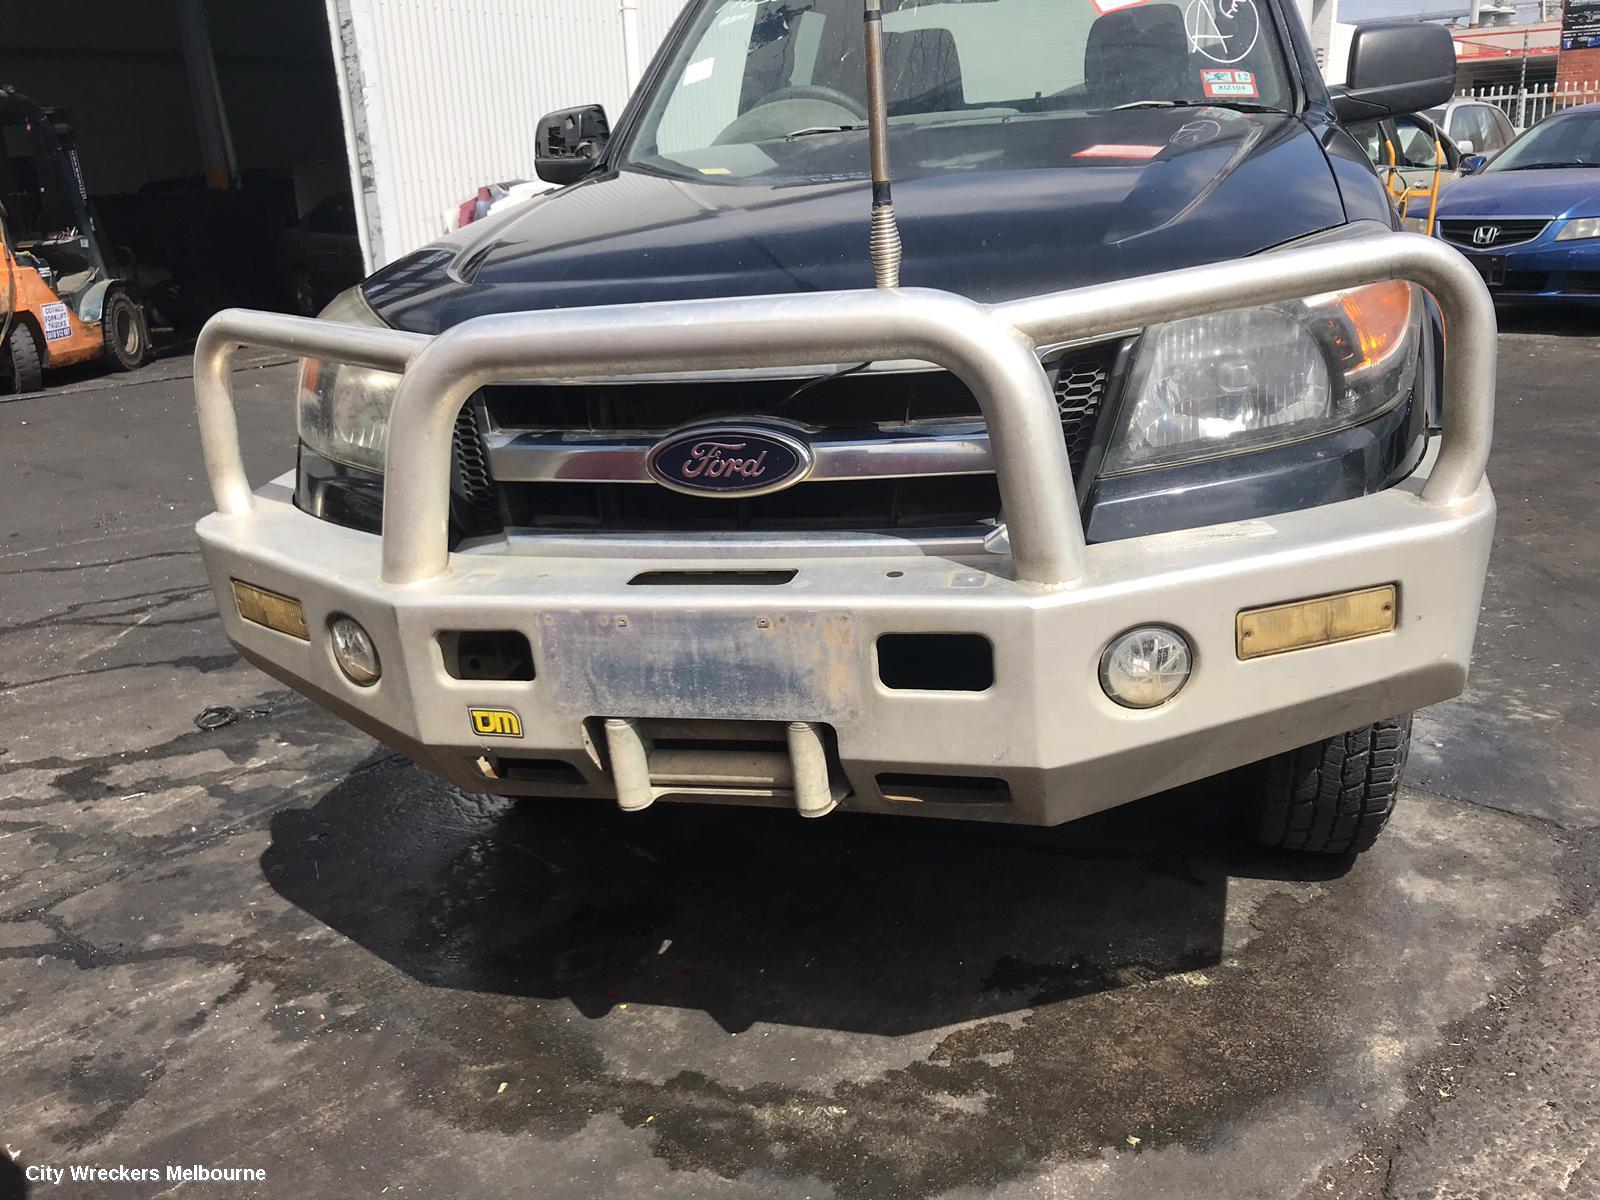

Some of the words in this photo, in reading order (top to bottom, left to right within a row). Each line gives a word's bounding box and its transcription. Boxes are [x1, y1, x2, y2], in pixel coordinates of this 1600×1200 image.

[45, 313, 68, 323] FORKLIFT
[48, 320, 68, 330] TRUCKS
[682, 441, 768, 479] Ford
[471, 709, 521, 735] TJM
